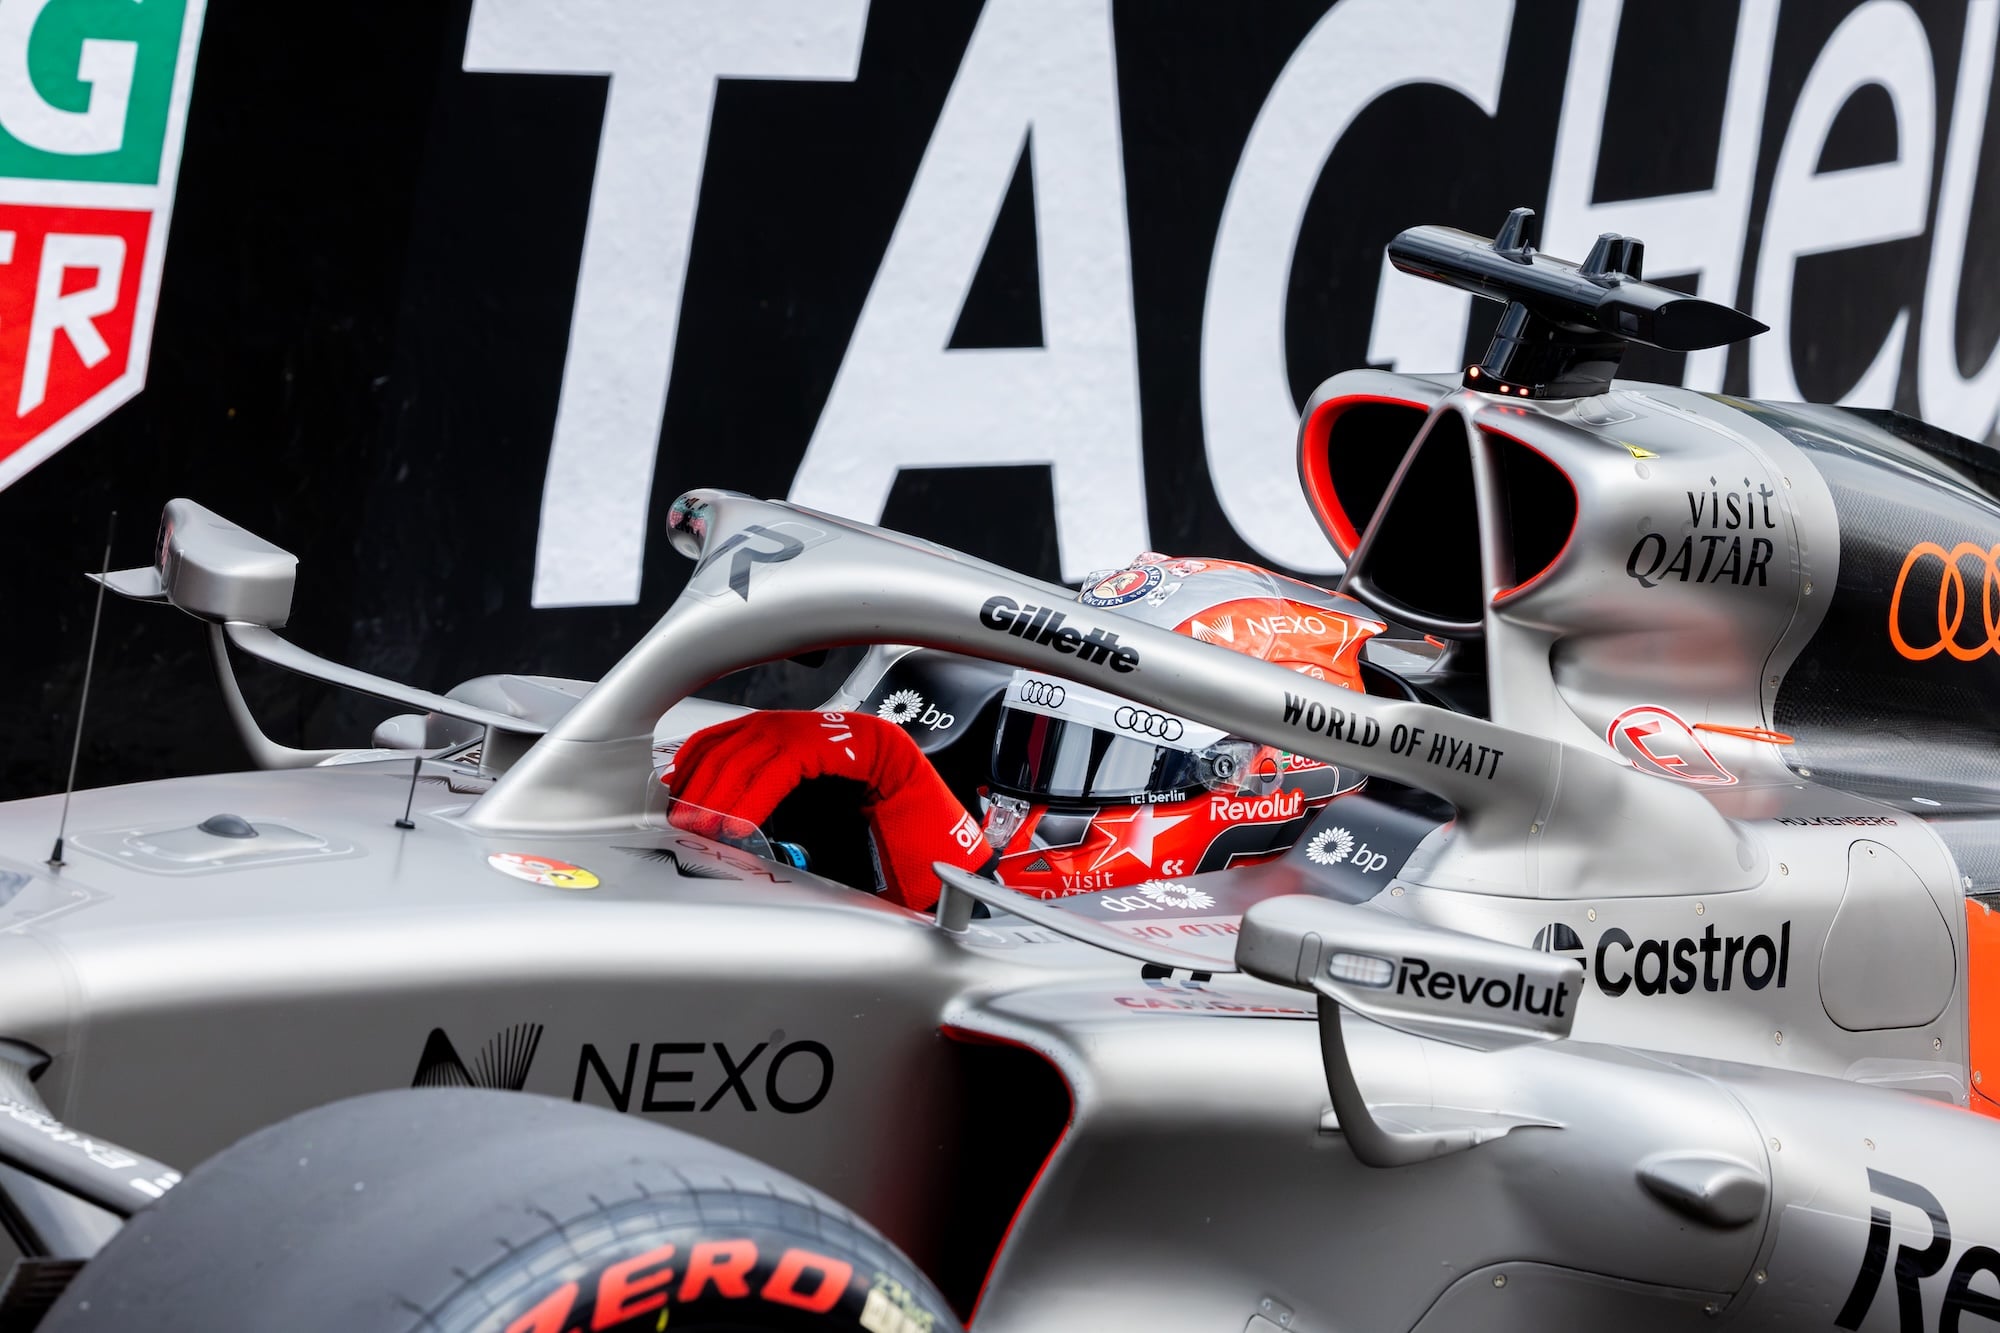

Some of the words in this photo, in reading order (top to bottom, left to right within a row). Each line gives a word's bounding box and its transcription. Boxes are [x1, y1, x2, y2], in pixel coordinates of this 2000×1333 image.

[462, 0, 1516, 608] TAG
[1687, 476, 1776, 529] visit
[1626, 533, 1774, 588] QATAR
[979, 595, 1140, 673] Gillette
[1245, 615, 1327, 636] NEXO
[919, 703, 955, 731] bp
[1283, 691, 1380, 748] WORLD
[1390, 724, 1425, 757] OF
[1427, 733, 1504, 780] HYATT
[1149, 790, 1186, 803] berlin
[1209, 792, 1302, 821] Revolut
[1062, 871, 1114, 889] visit
[1350, 841, 1388, 874] bp
[1595, 920, 1792, 999] Castrol
[1396, 956, 1569, 1019] Revolut
[572, 1040, 835, 1115] NEXO
